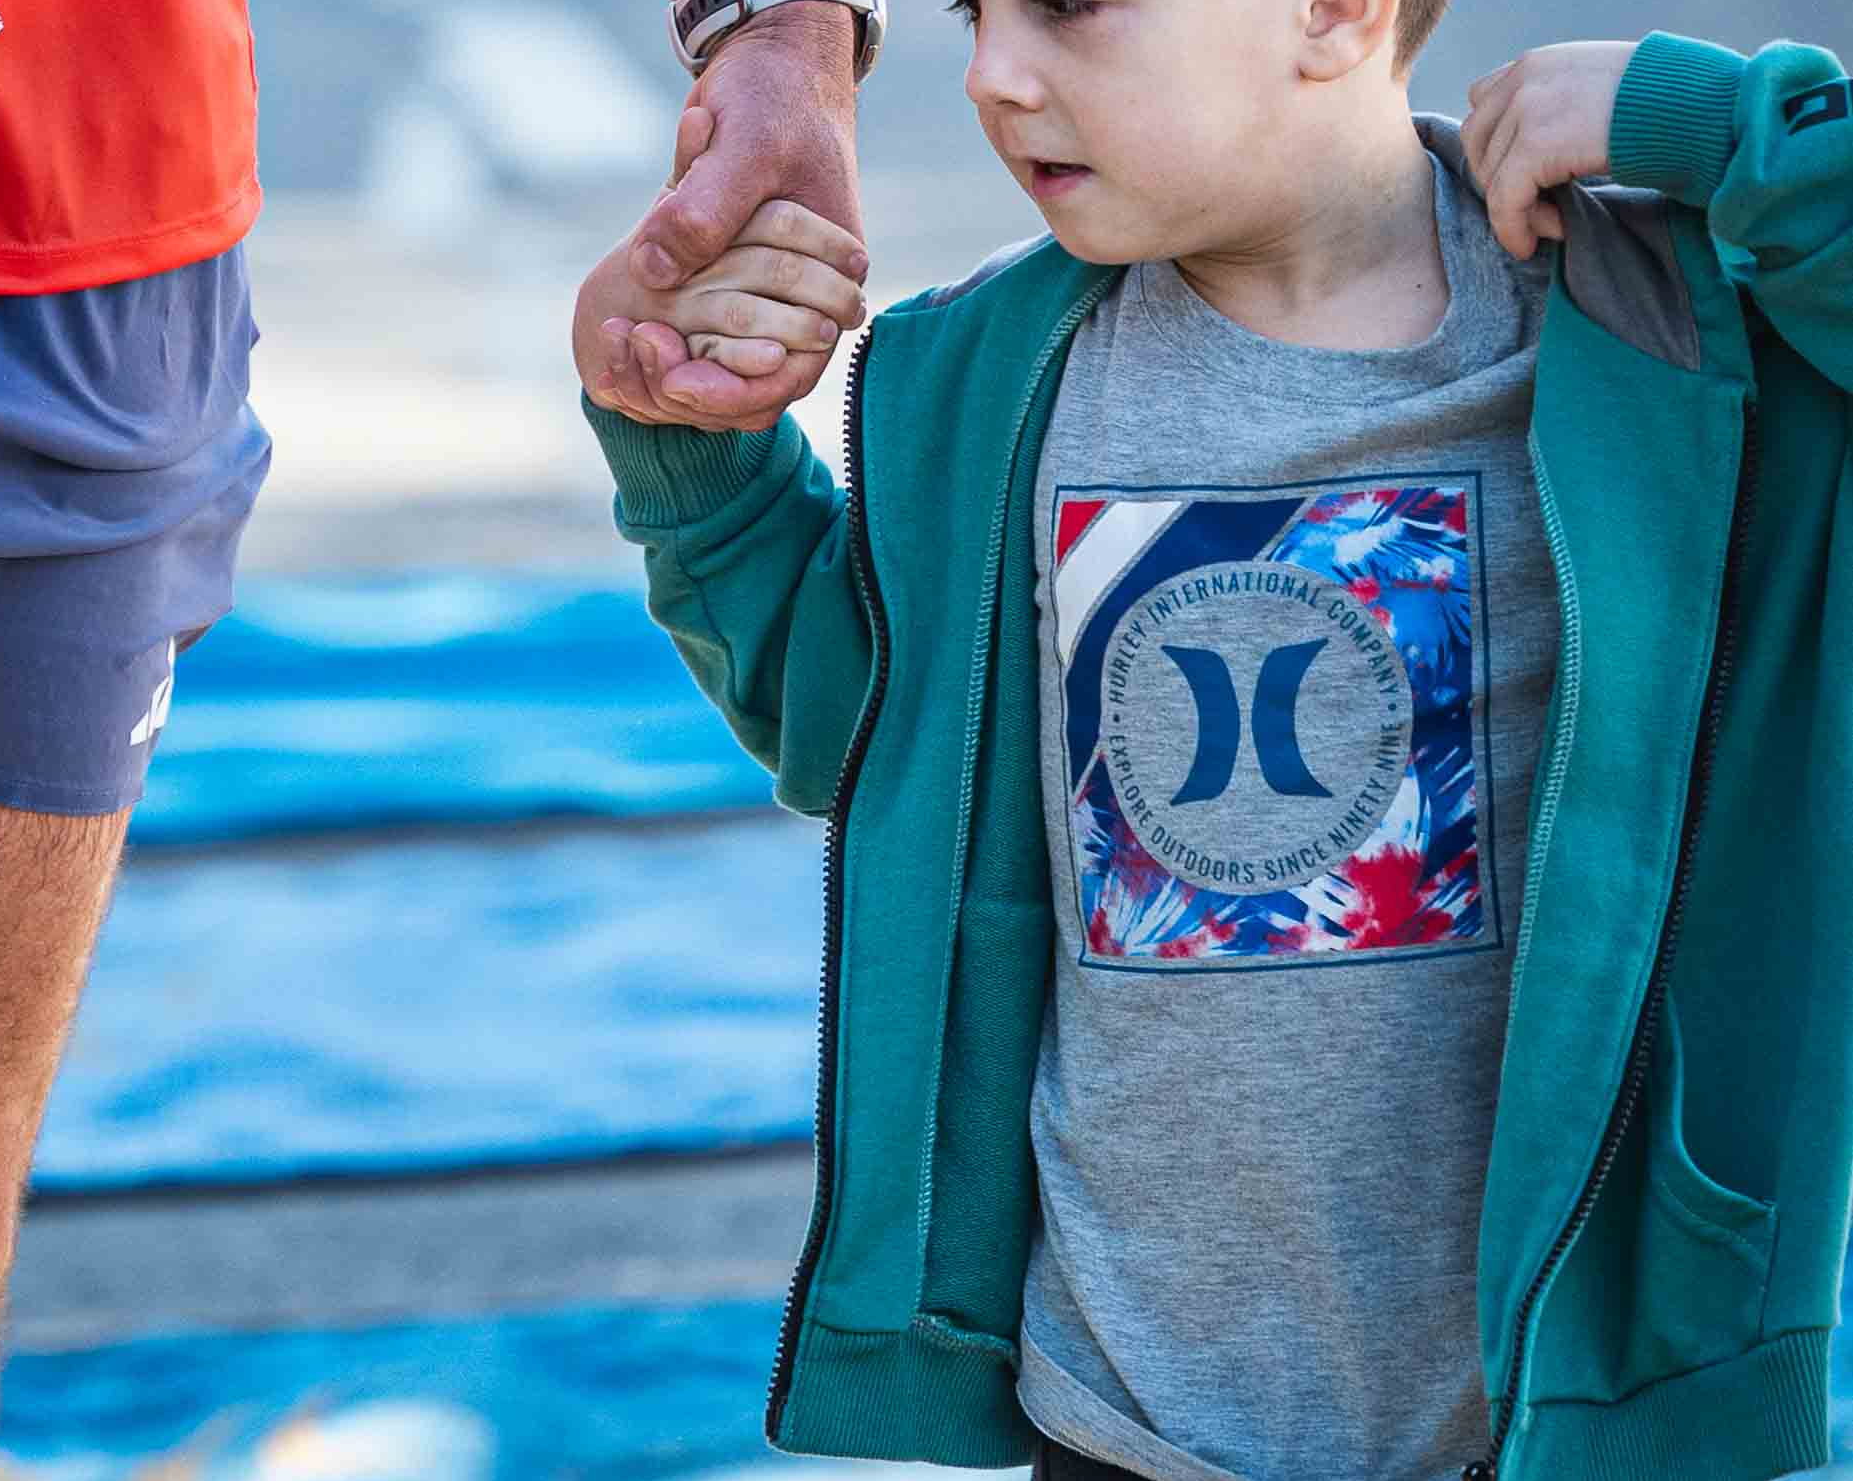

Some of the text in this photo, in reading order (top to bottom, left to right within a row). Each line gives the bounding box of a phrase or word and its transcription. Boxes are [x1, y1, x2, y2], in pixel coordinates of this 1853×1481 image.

[1109, 570, 1399, 706] HURLEY INTERNATIONAL COMPANY
[1109, 722, 1403, 885] EXPLORE OUTDOORS SINCE NINETY NINE
